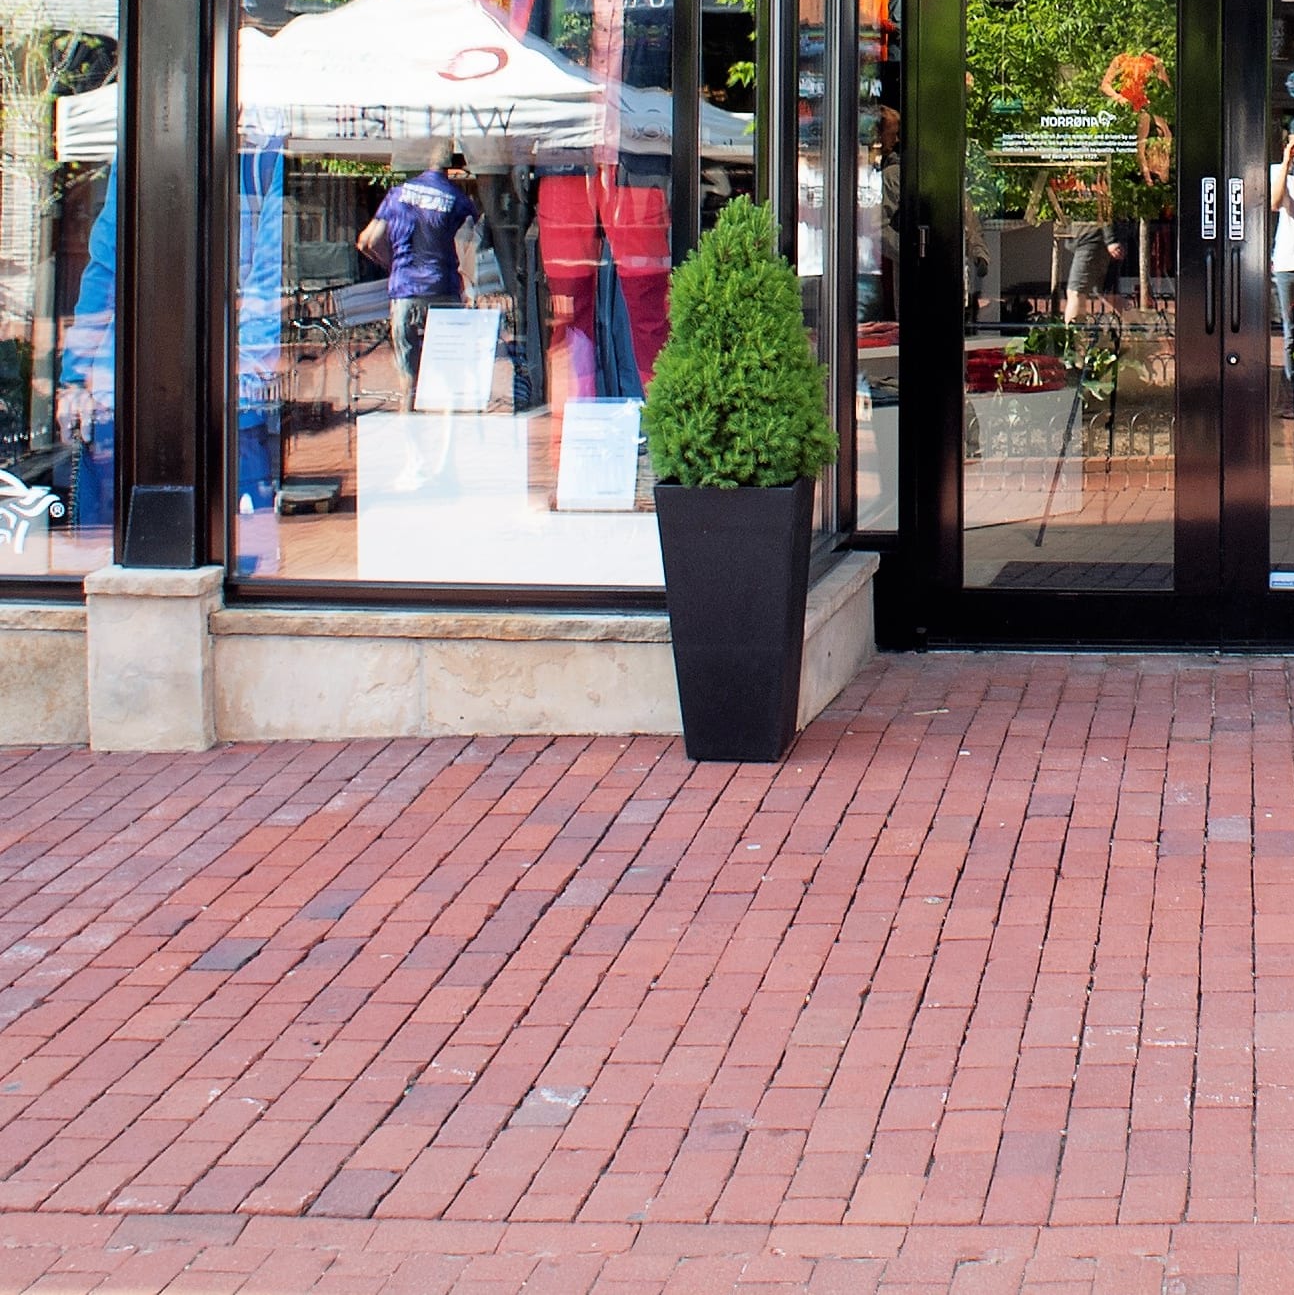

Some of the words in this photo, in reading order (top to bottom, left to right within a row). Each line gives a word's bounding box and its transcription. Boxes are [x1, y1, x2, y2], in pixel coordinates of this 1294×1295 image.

[1040, 116, 1099, 127] NORRØNA
[1204, 183, 1214, 224] PULL
[1231, 184, 1242, 225] PULL
